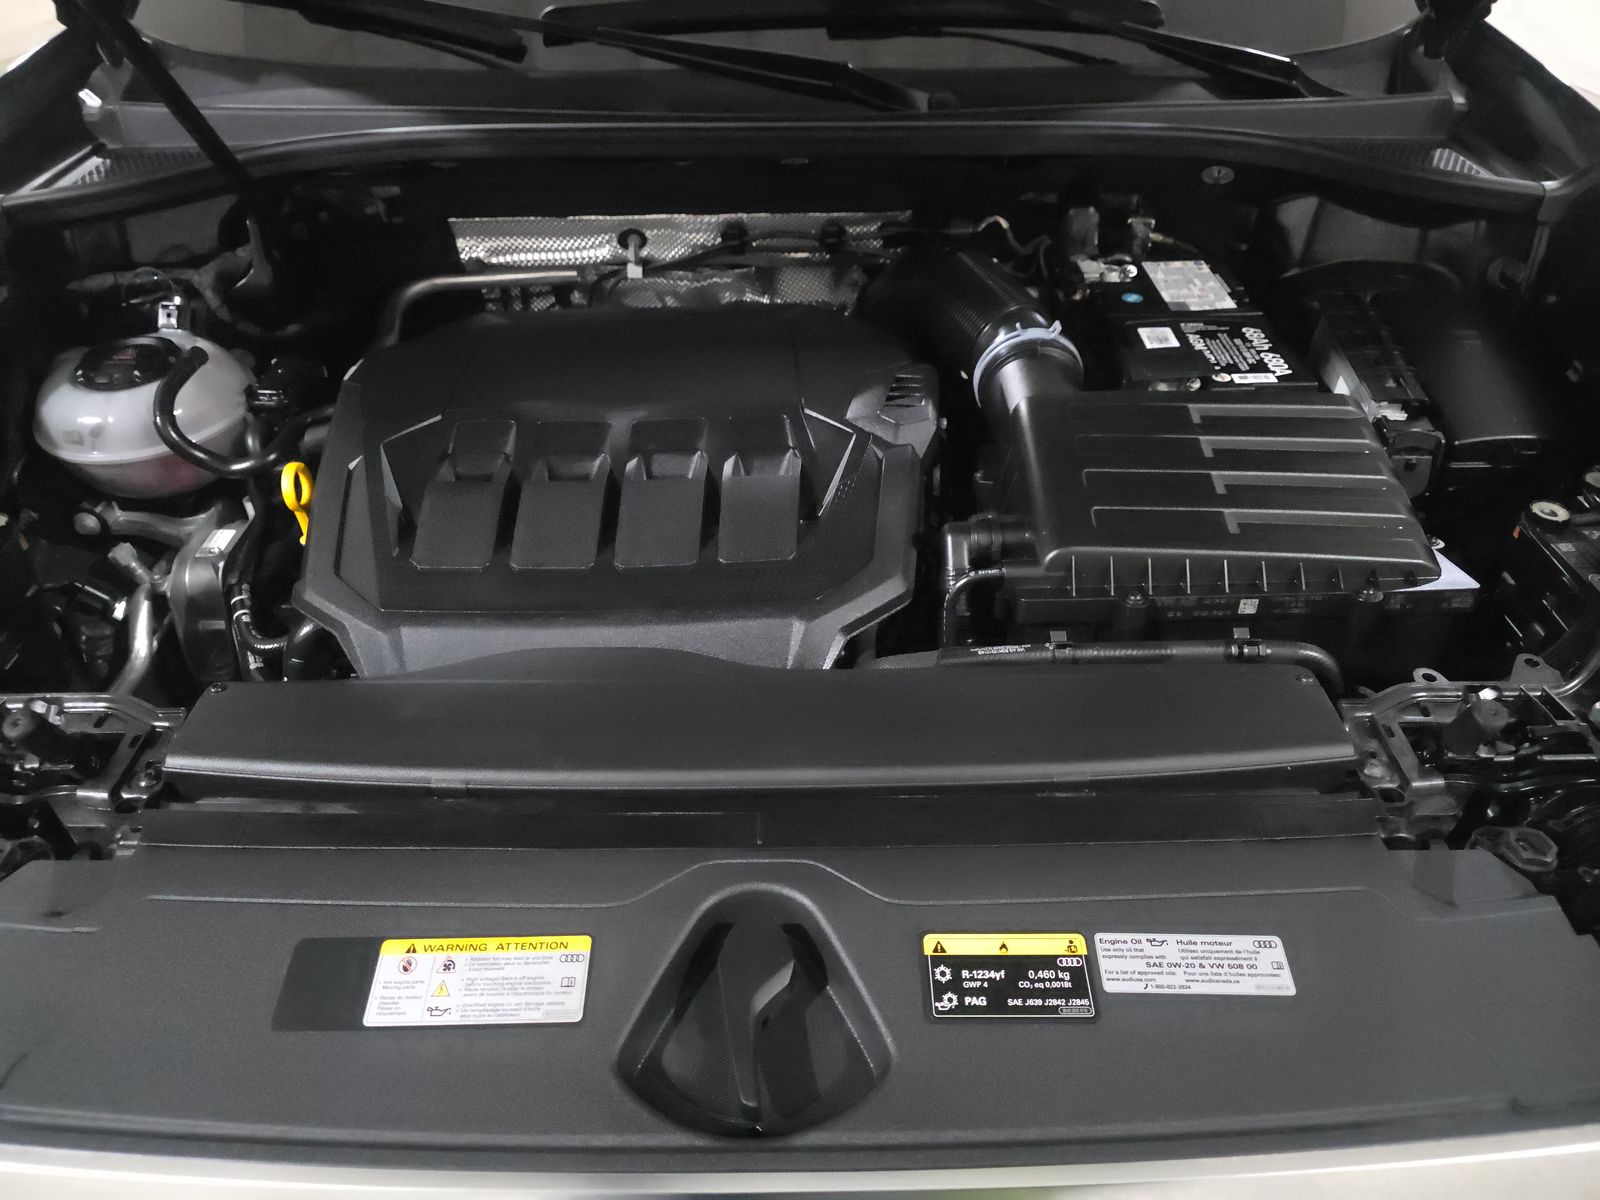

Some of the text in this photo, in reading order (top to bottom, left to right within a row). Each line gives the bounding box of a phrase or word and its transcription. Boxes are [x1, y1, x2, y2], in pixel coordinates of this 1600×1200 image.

[1241, 326, 1273, 351] 68Ah
[1260, 352, 1293, 377] 680A
[423, 941, 569, 953] WARNING ATTENTION
[1099, 938, 1129, 946] Engine
[1145, 961, 1164, 969] SAE
[1166, 961, 1196, 969] 0W-20
[961, 969, 1006, 981] R-1234yf
[1028, 970, 1070, 981] 0,460 kg
[1034, 982, 1044, 990] eq
[964, 996, 987, 1006] PAG
[1007, 998, 1090, 1006] SAE J639 J2842 J2845
